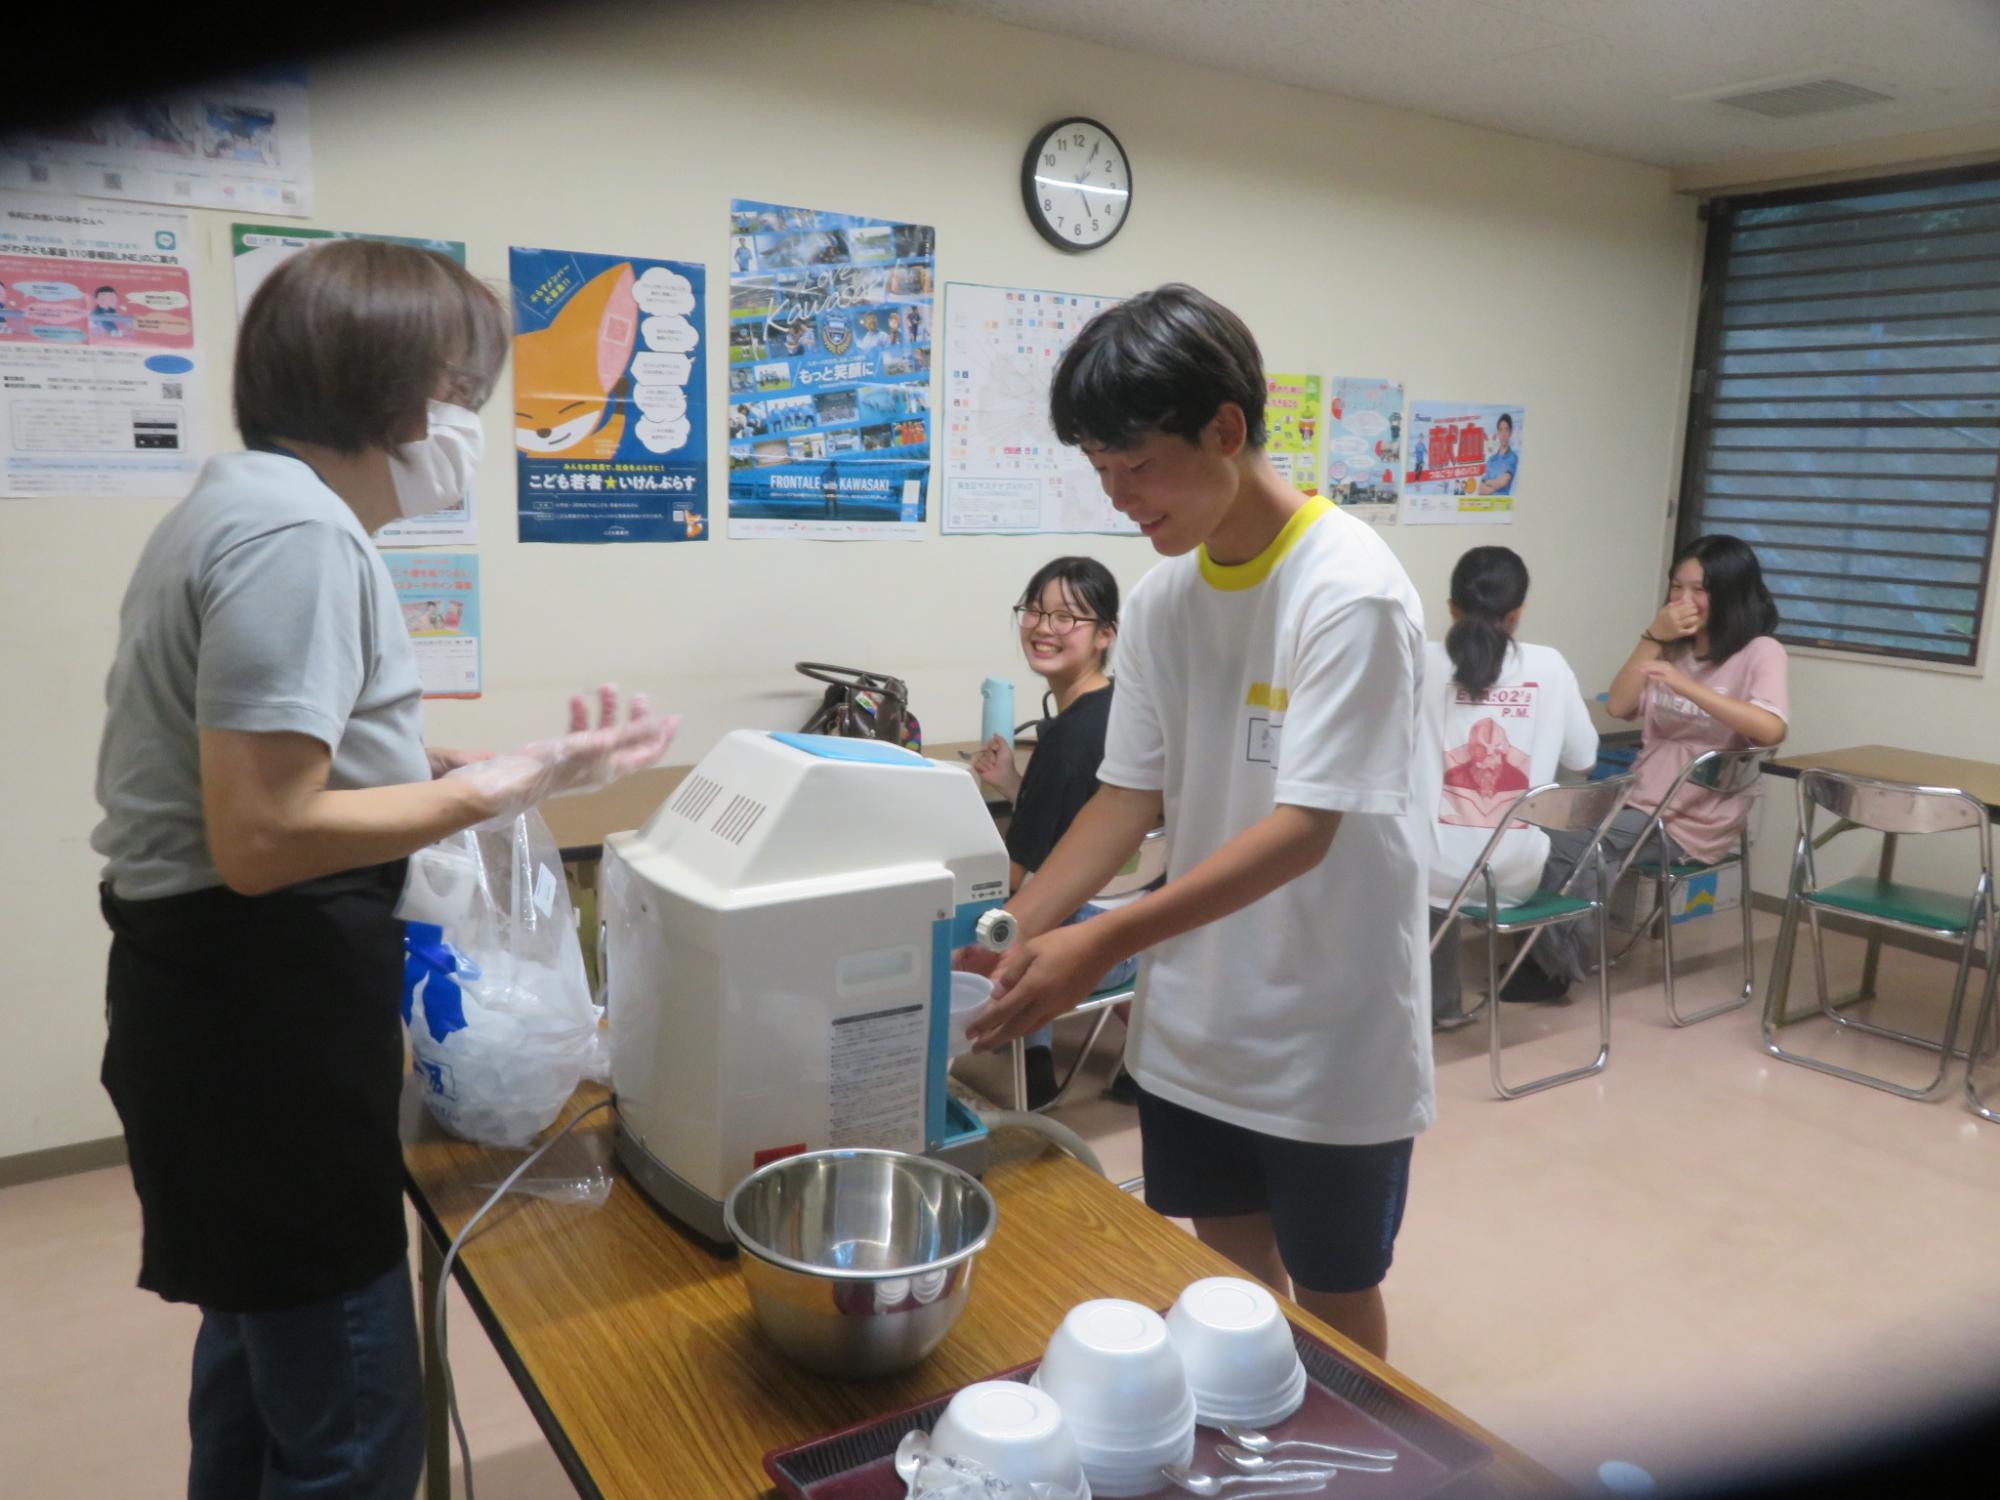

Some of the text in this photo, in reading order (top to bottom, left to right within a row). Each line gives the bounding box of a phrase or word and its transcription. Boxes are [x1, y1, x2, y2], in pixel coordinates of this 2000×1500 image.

[1057, 138, 1067, 151] 11
[1073, 134, 1085, 148] 12
[1043, 153, 1056, 167] 10
[1105, 160, 1112, 172] 2
[1044, 199, 1052, 211] 8
[1104, 203, 1111, 215] 4
[1057, 216, 1064, 228] 7
[1092, 219, 1099, 231] 5
[1074, 223, 1081, 236] 6
[799, 362, 874, 384] もっと笑顔に
[1428, 423, 1487, 469] 献血
[770, 475, 821, 489] FRONTALE
[839, 477, 889, 491] KAWASAKI
